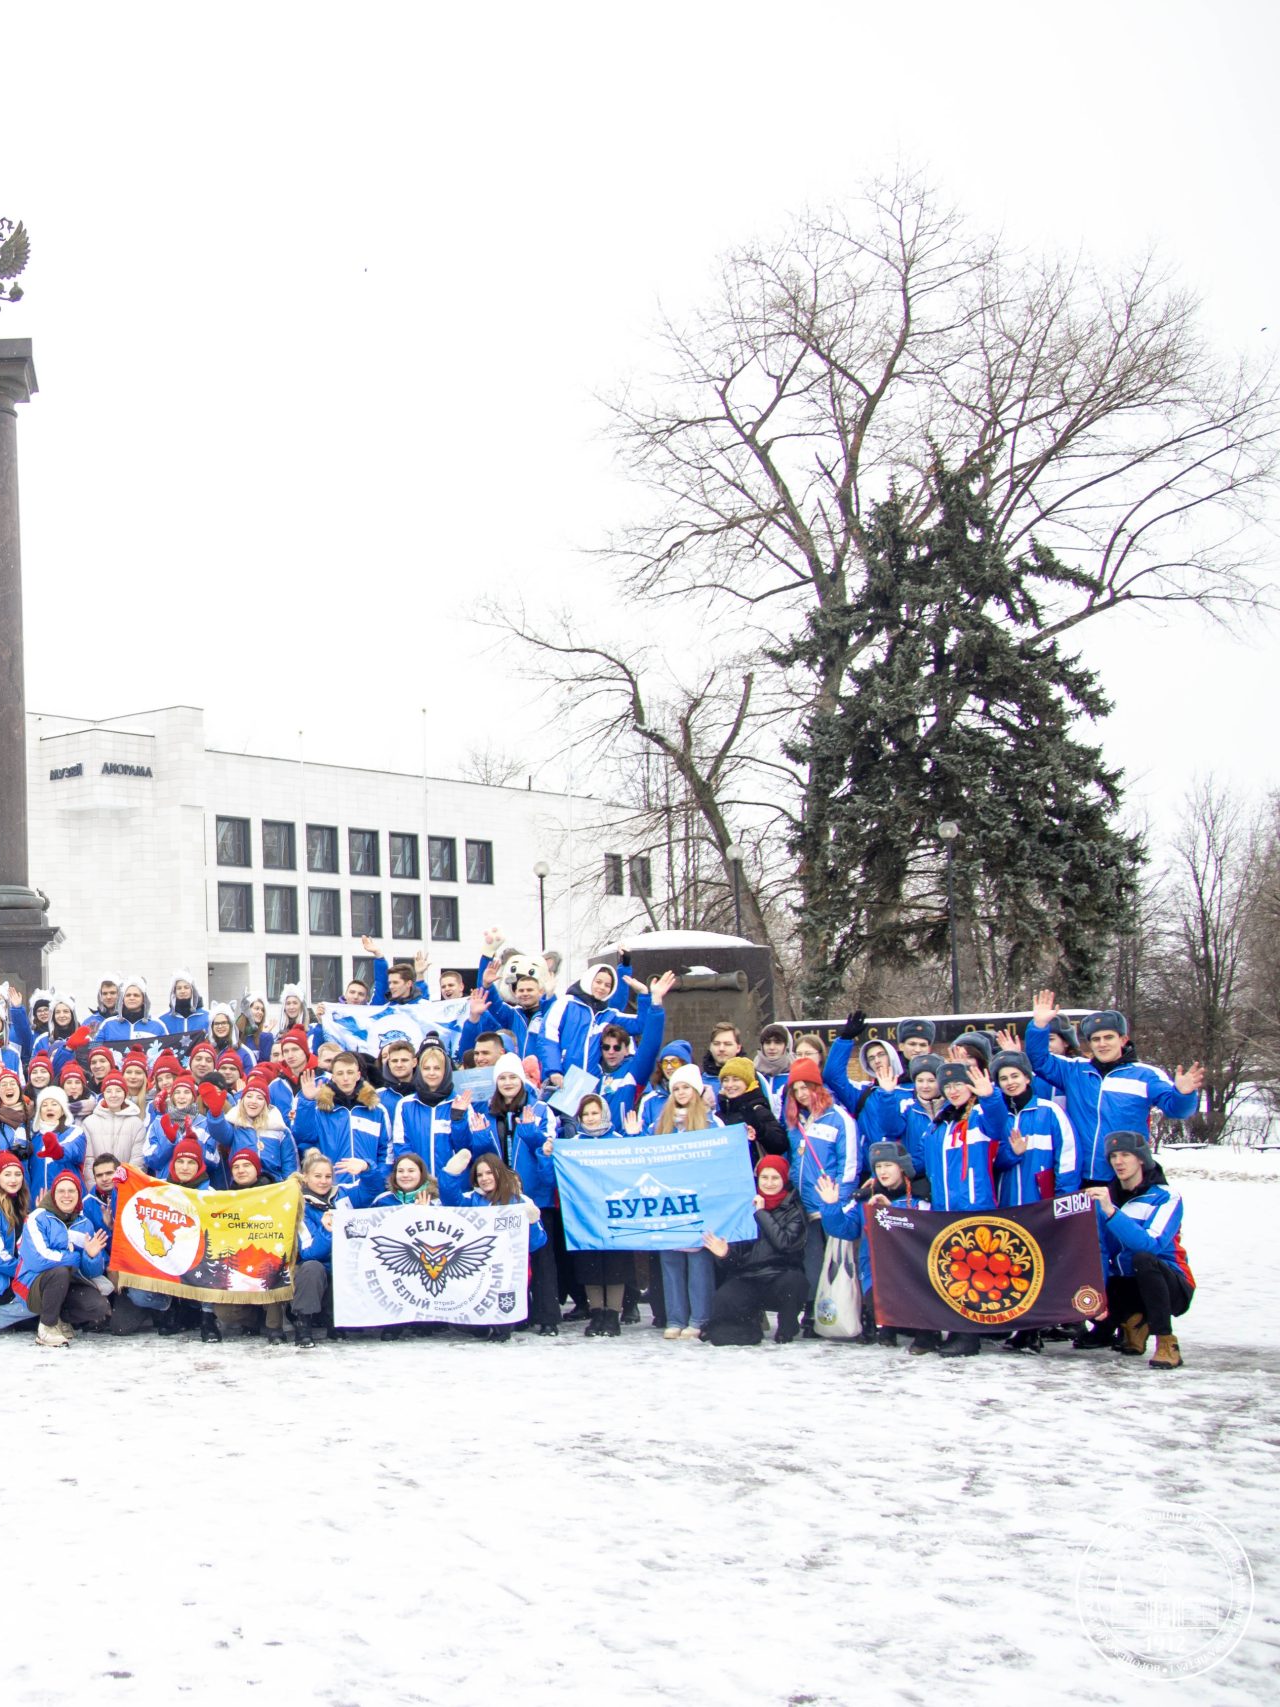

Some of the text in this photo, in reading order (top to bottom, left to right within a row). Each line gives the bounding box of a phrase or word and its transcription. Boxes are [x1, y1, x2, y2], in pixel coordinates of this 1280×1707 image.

[49, 762, 153, 780] МУЗЕЙ ДИОРАМА
[635, 1136, 728, 1155] ГОСУДАРСТВЕННЫЙ
[579, 1150, 713, 1166] ТЕХНИЧЕСКИЙ УНИВЕРСИТЕТ
[606, 1194, 701, 1219] БУРАН
[1072, 1191, 1091, 1212] ВСО
[138, 1205, 188, 1225] ЛЕГЕНДА
[211, 1212, 241, 1221] ОТРЯД
[227, 1221, 274, 1230] СНЕЖНОГО
[405, 1220, 465, 1242] БЕЛЫЙ
[248, 1232, 285, 1240] ДЕСАНТА
[365, 1269, 405, 1318] БЕЛЫЙ
[392, 1278, 431, 1311] БЕЛЫЙ
[473, 1262, 505, 1318] БЕЛЫЙ
[960, 1305, 1026, 1324] КЛЮКВА
